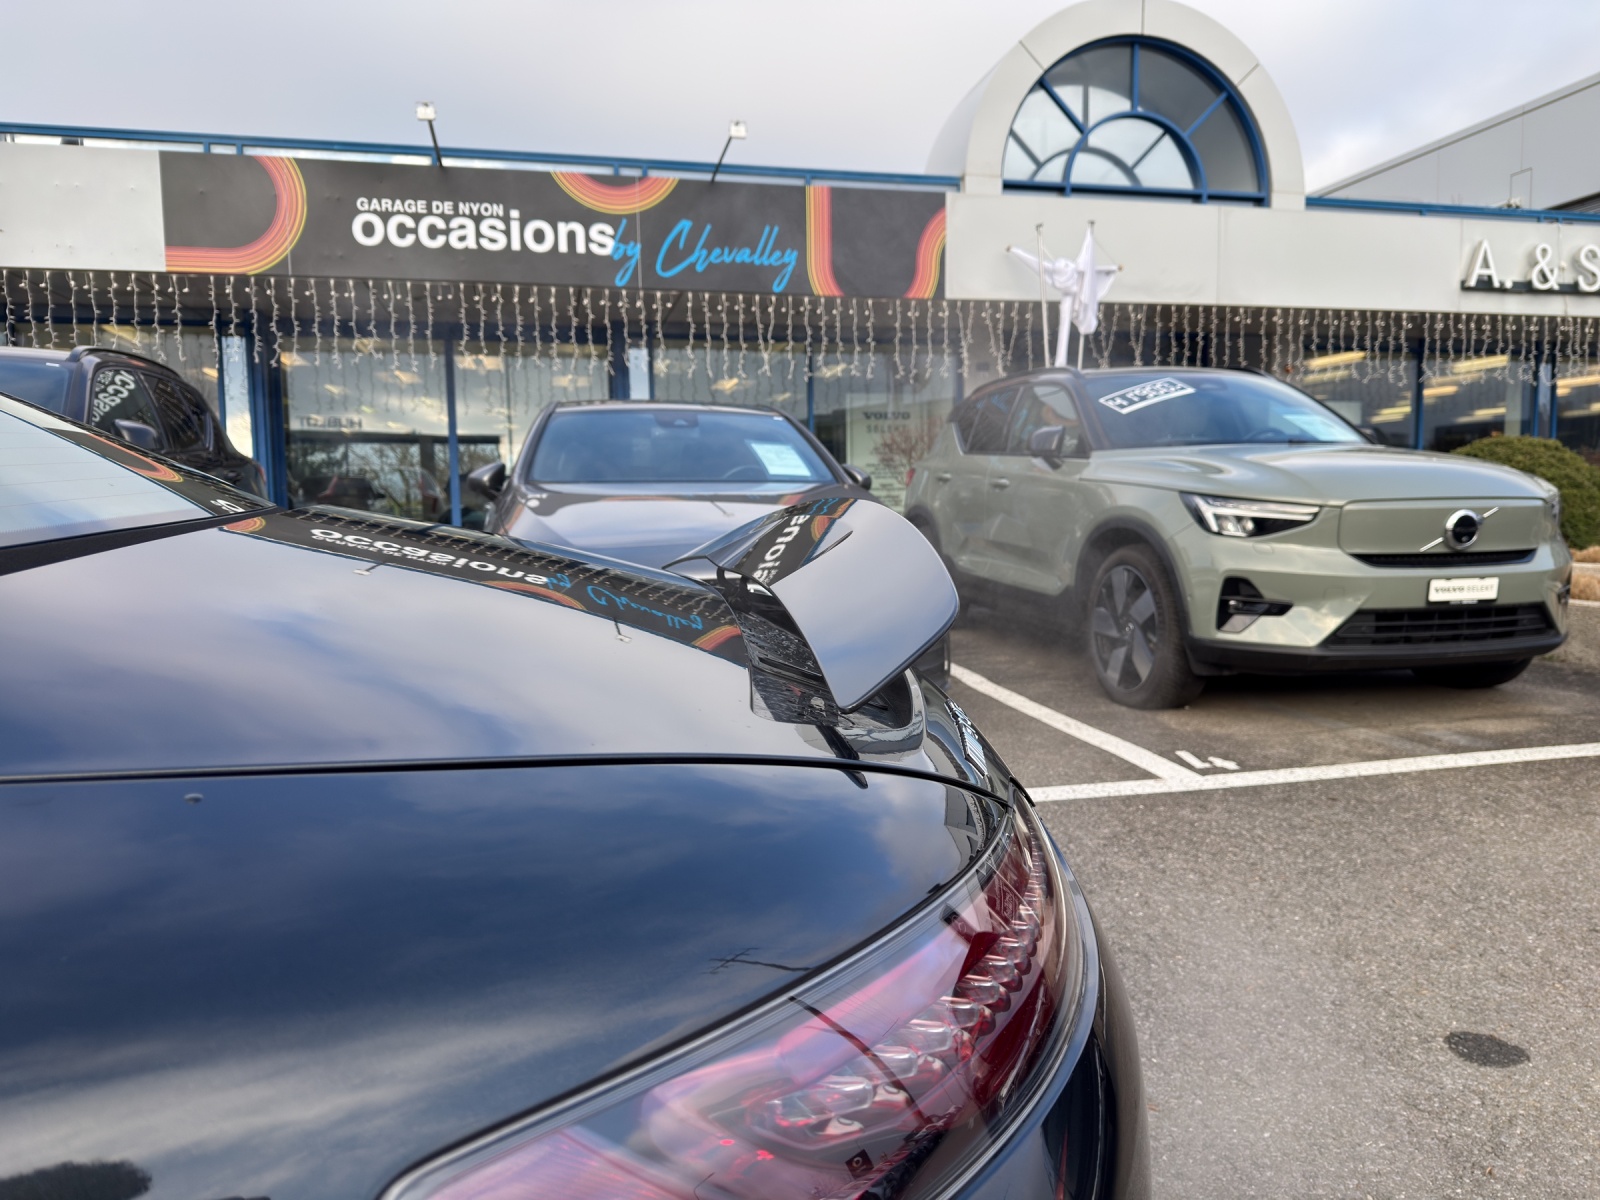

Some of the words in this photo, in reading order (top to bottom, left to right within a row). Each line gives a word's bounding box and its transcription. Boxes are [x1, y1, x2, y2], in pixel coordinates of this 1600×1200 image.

[356, 196, 427, 214] GARAGE
[432, 200, 454, 215] DE
[458, 202, 504, 217] NYON
[351, 208, 616, 256] occasions
[609, 217, 641, 288] by
[655, 218, 798, 293] Chevalley
[1464, 239, 1513, 289] A.
[1530, 243, 1560, 290] &
